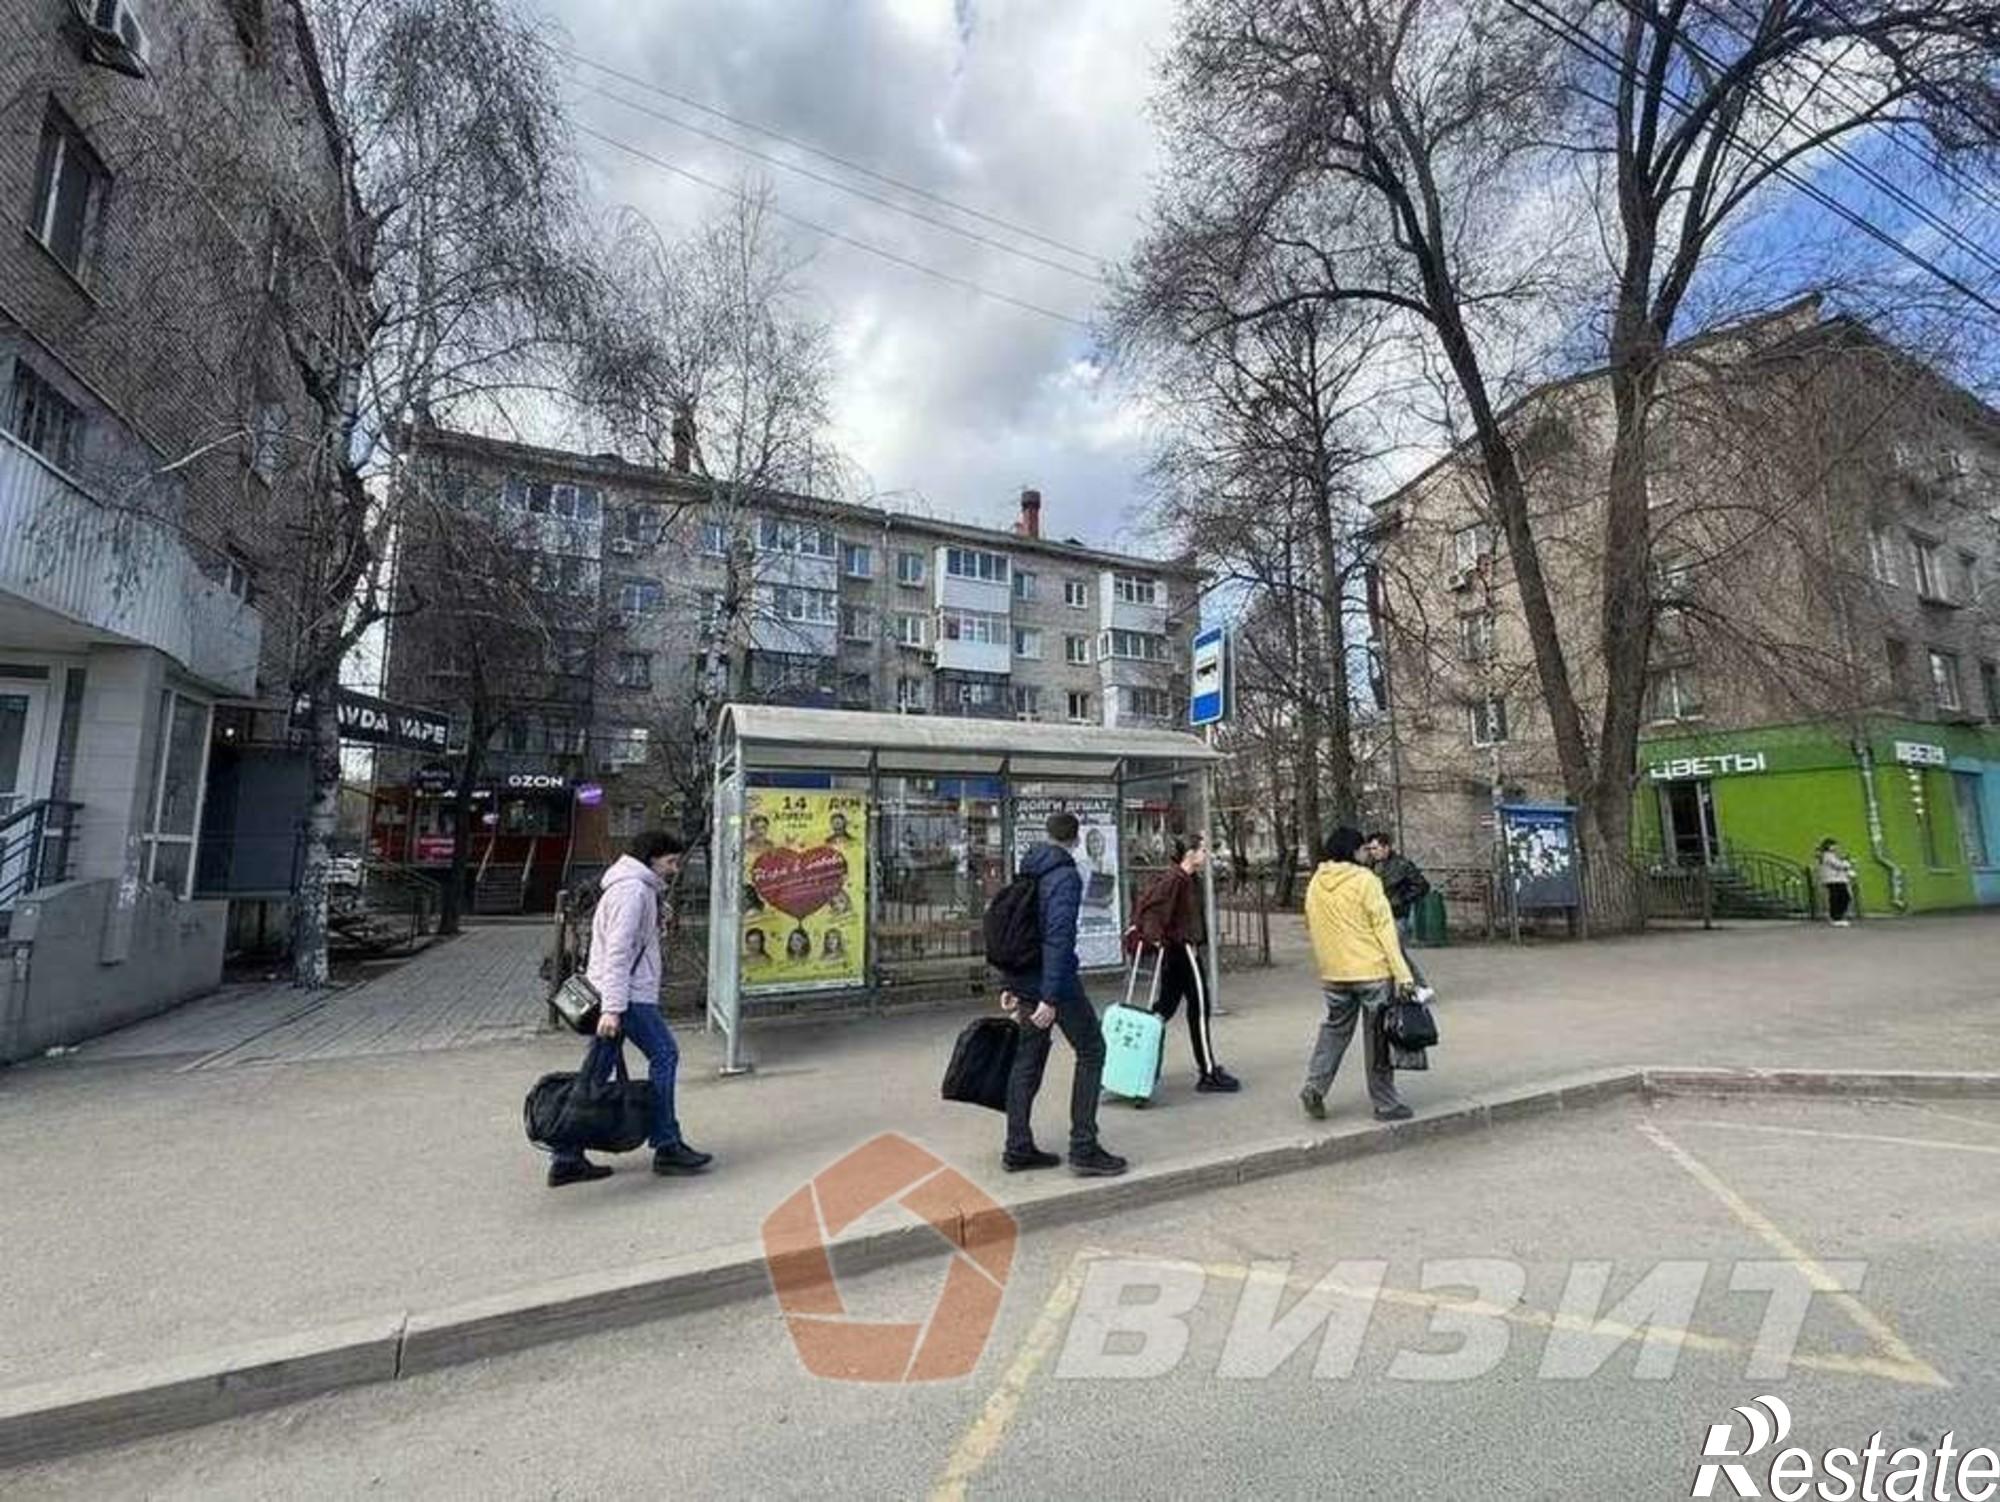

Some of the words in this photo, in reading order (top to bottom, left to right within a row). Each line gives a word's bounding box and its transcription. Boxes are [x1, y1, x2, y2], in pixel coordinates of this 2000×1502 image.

[400, 716, 446, 744] VAPE
[1649, 752, 1767, 780] ЦВЕТЫ
[509, 775, 564, 787] OZON
